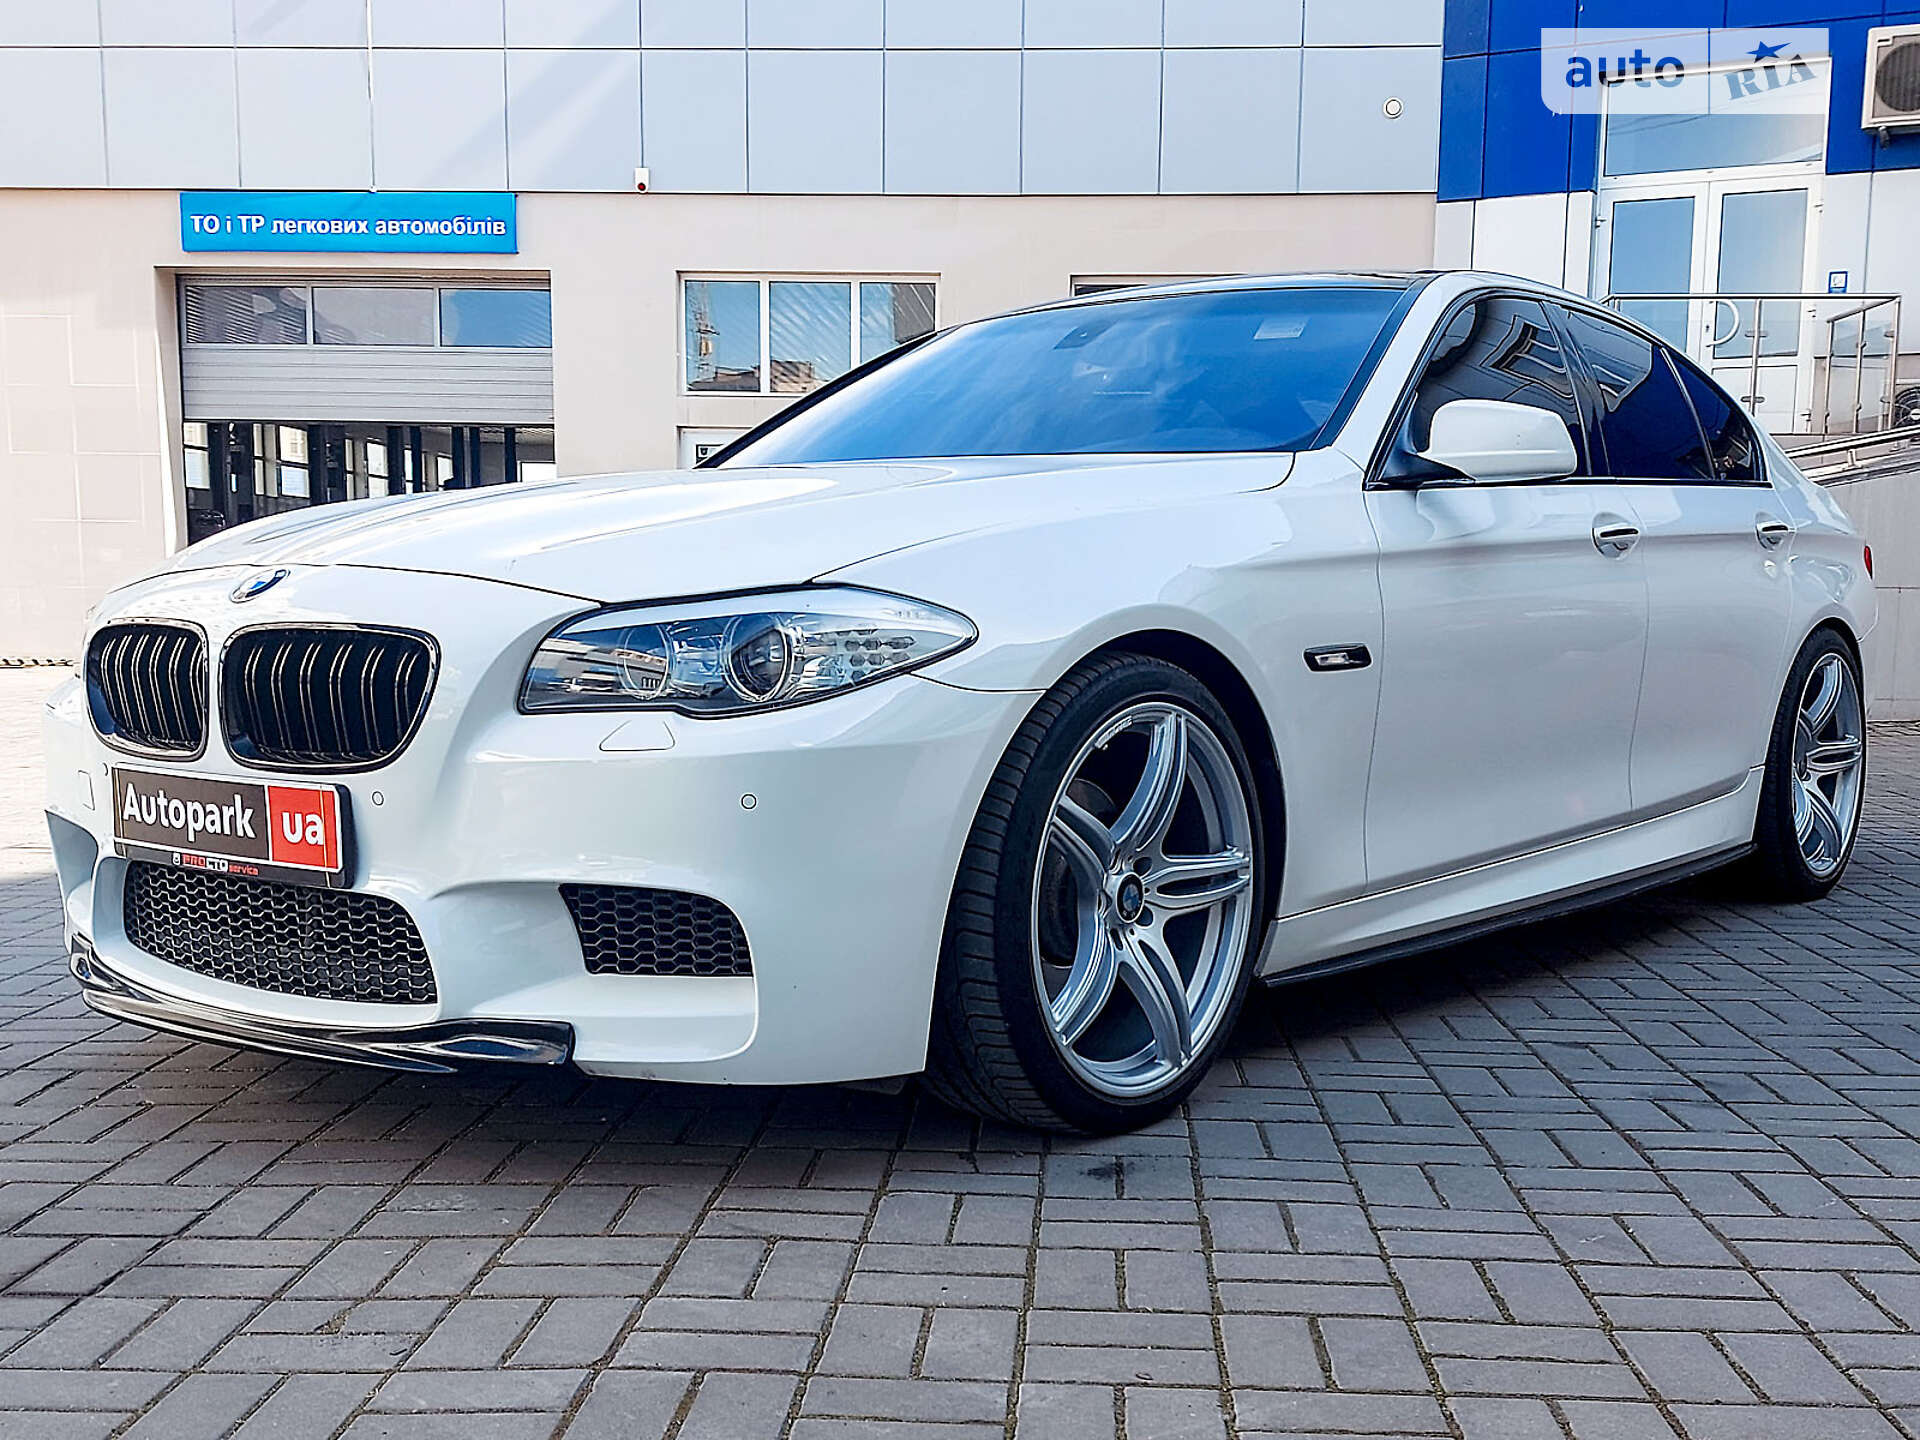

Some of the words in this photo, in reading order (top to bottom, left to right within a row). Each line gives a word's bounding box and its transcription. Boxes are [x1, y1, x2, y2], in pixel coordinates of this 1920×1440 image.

[190, 215, 220, 233] ТО
[225, 215, 232, 233] і
[237, 215, 265, 233] ТР
[271, 219, 369, 235] легкових
[374, 216, 506, 235] автомобілів
[122, 783, 255, 842] Autopark
[281, 810, 324, 845] ua
